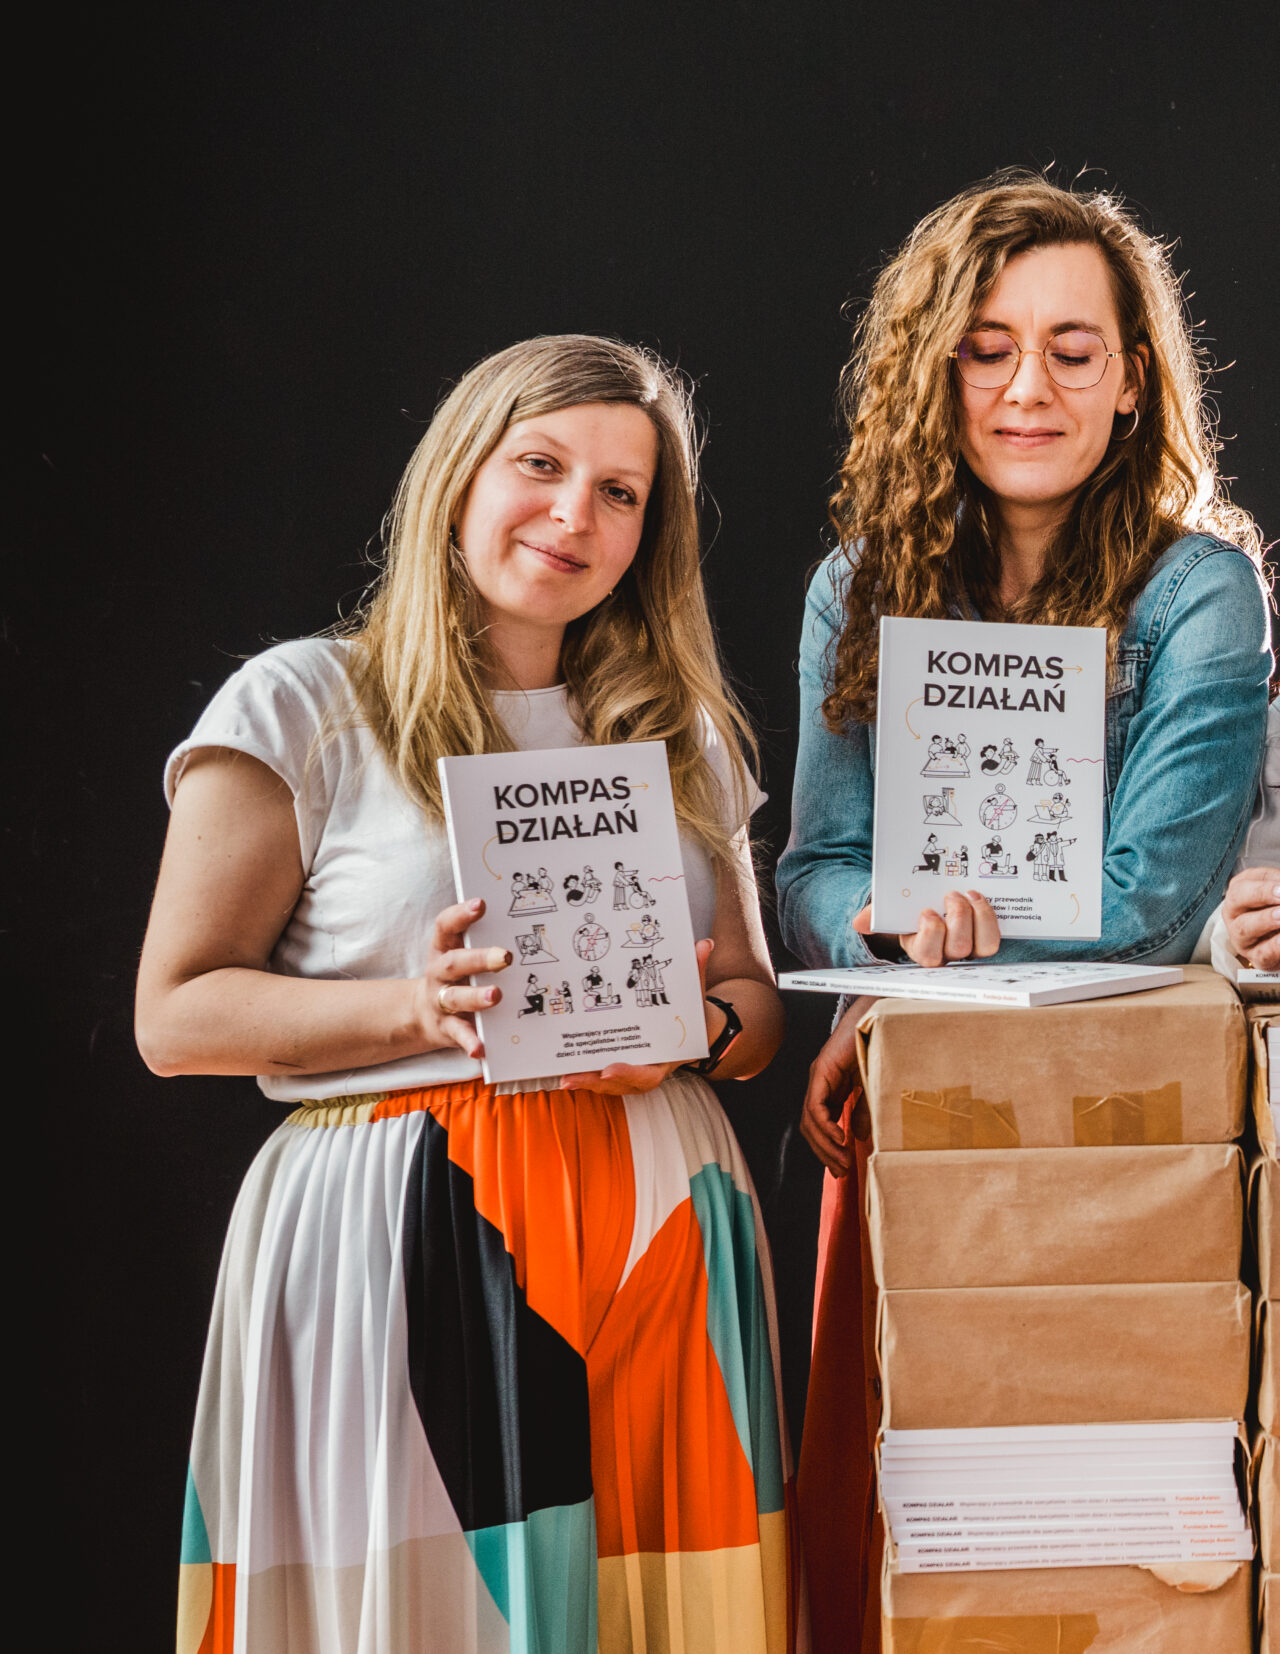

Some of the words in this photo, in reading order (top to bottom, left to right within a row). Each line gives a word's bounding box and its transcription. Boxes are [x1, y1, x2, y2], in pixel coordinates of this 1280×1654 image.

[927, 650, 1064, 680] KOMPAS
[923, 683, 1066, 713] DZIAŁAŃ
[493, 775, 631, 810] KOMPAS
[495, 802, 639, 845] DZIAŁAŃ
